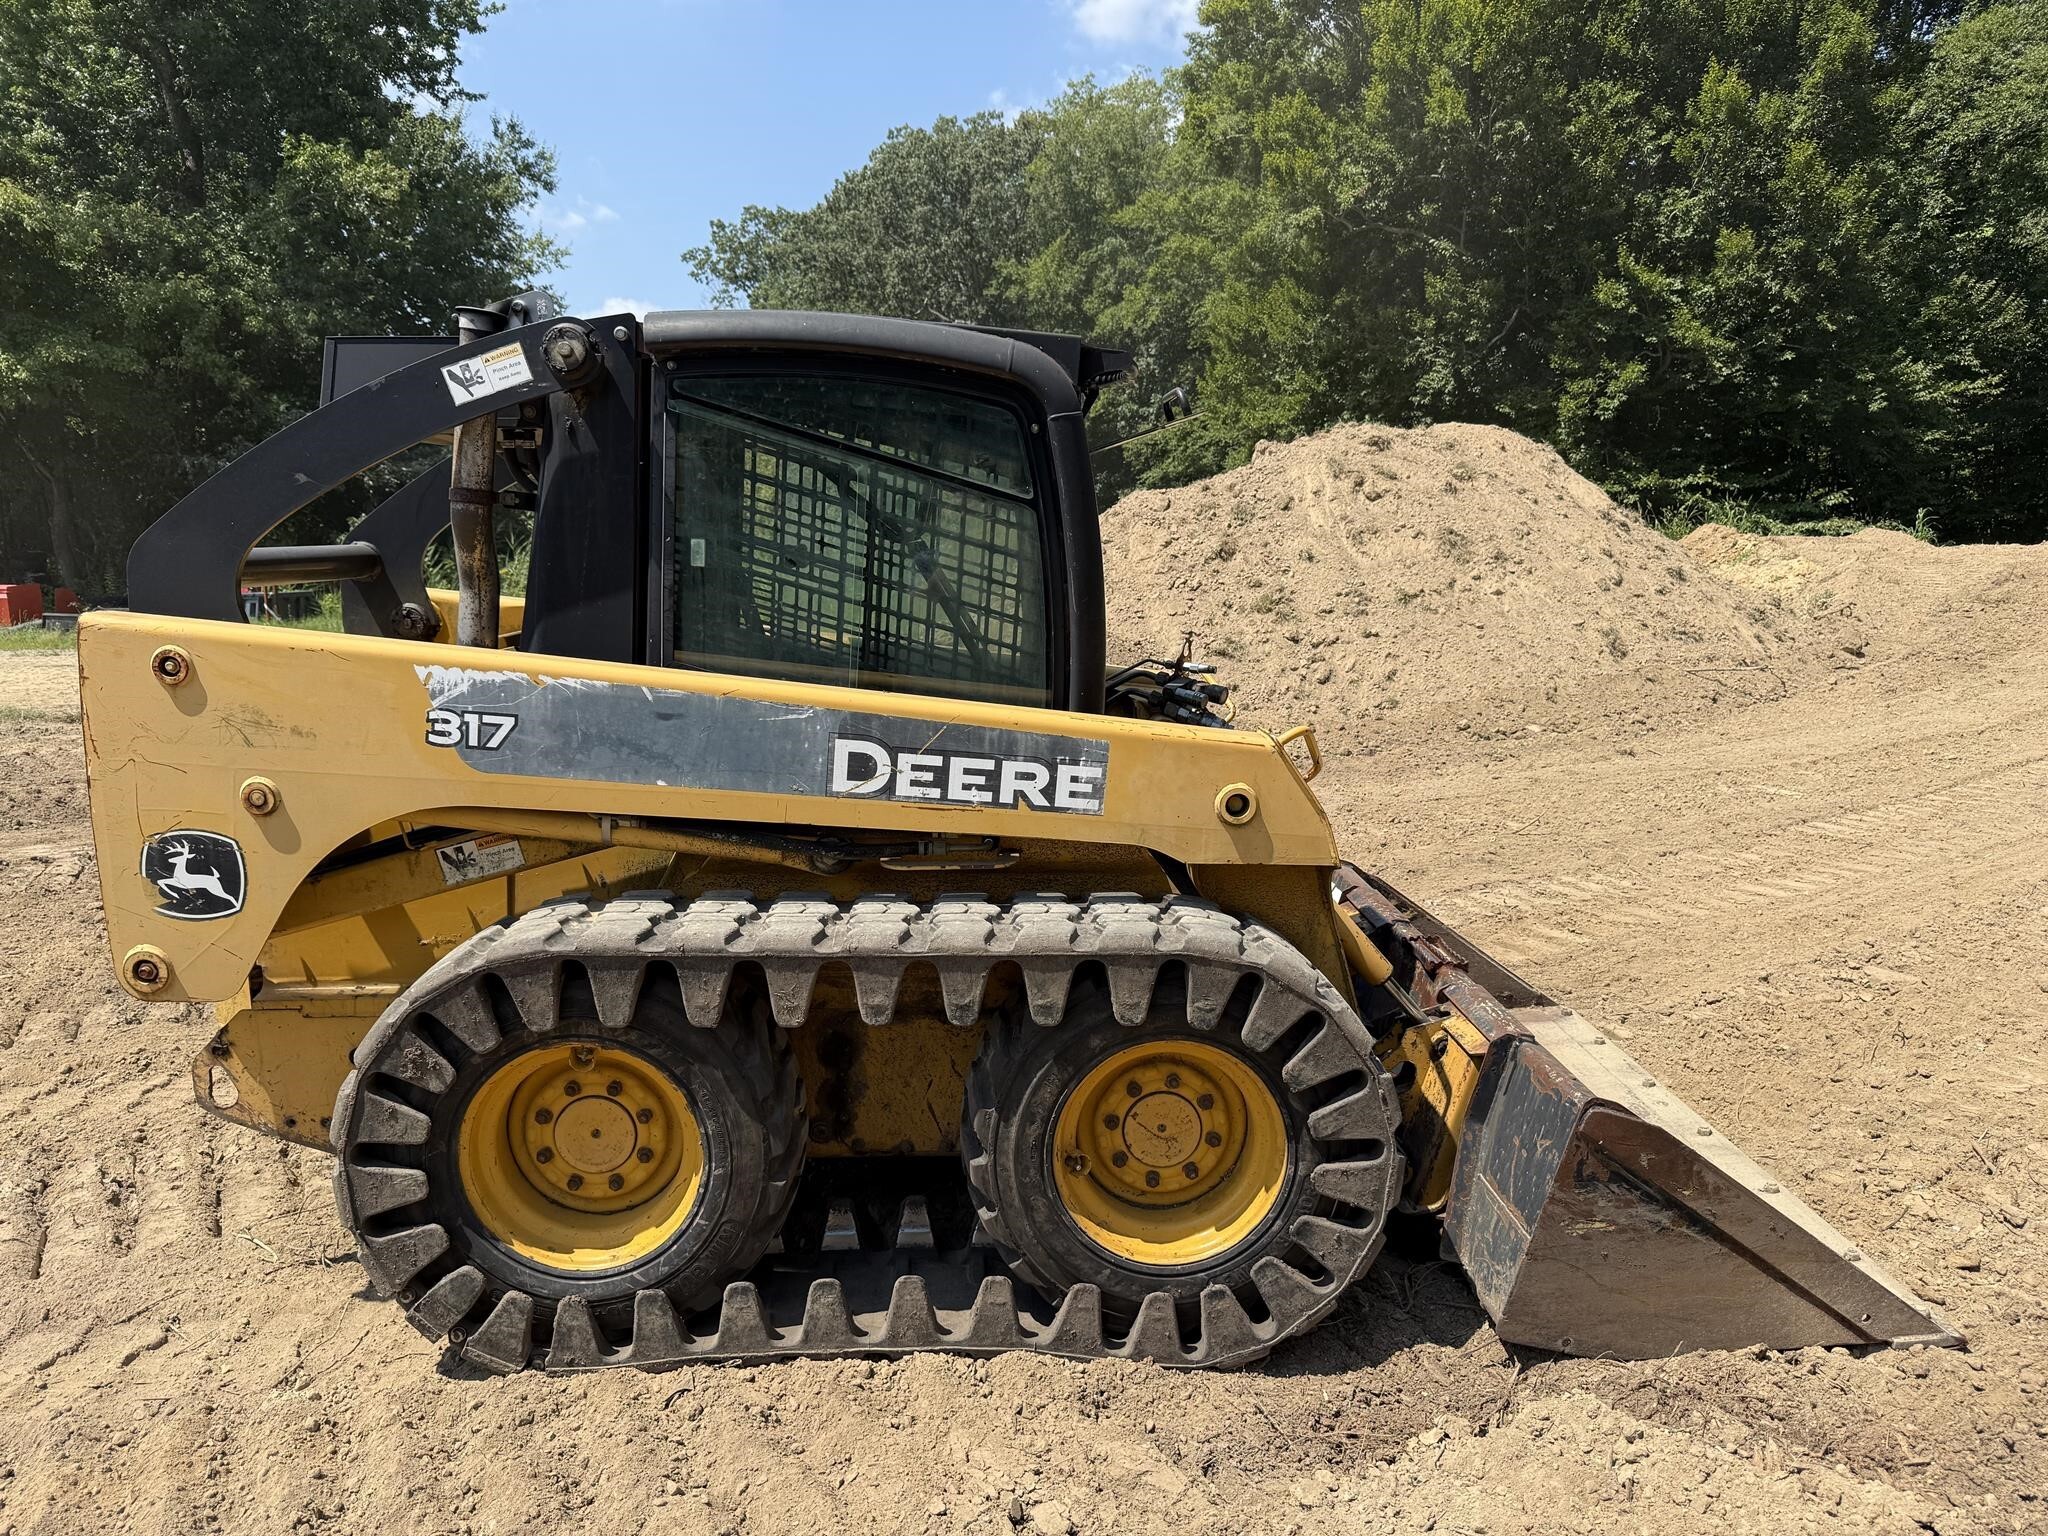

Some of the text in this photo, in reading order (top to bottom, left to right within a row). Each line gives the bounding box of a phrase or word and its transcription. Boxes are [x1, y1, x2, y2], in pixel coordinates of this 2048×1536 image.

[490, 347, 518, 361] WARNING
[493, 361, 522, 373] Pinch Area
[425, 707, 519, 751] 317
[831, 738, 1103, 810] DEERE
